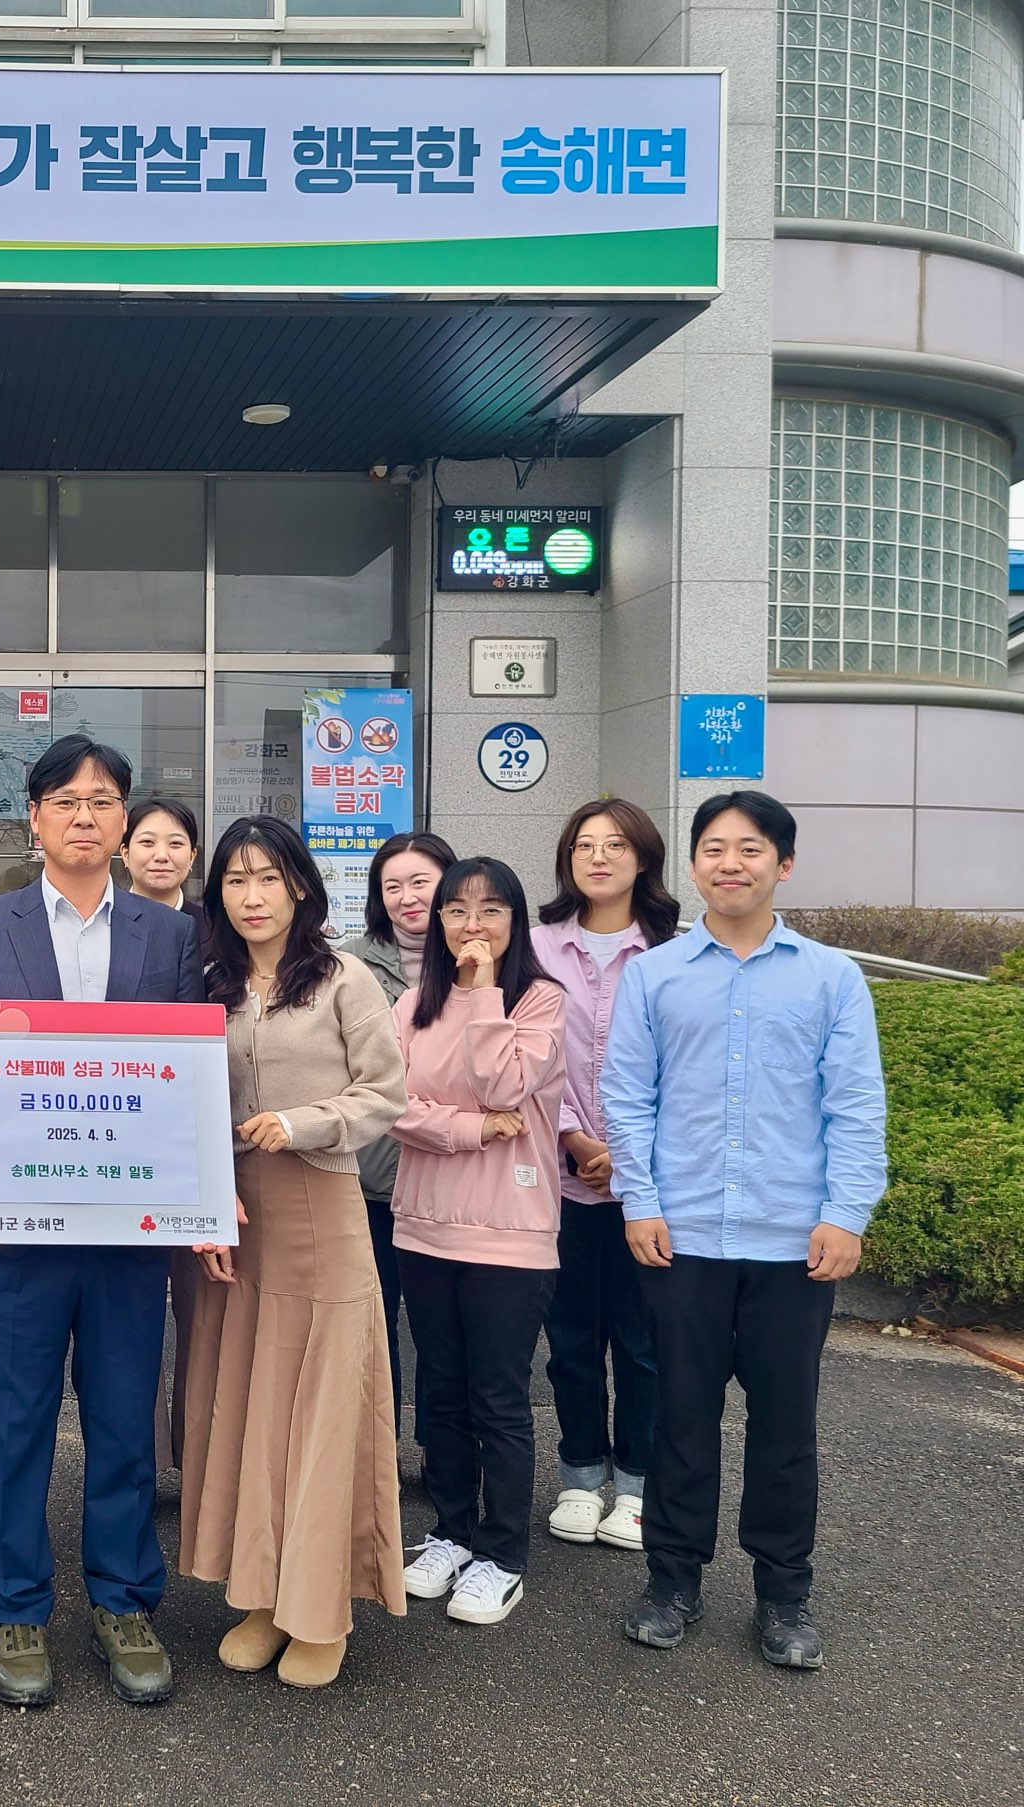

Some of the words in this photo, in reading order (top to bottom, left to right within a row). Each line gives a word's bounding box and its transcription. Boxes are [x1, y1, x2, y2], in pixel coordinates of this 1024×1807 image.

[78, 125, 268, 193] 잘살고
[292, 125, 481, 195] 행복한
[500, 126, 687, 195] 송해면
[453, 509, 476, 523] 우리
[479, 509, 503, 523] 동네
[506, 509, 553, 523] 미세먼지
[556, 509, 591, 523] 알리미
[244, 743, 289, 758] 강화군
[498, 749, 530, 769] 29
[310, 765, 404, 787] 불법소각
[500, 770, 528, 778] 전망대로
[335, 791, 381, 814] 금지
[308, 825, 354, 837] 푸른하늘을
[356, 825, 375, 837] 위한
[308, 838, 336, 849] 올바른
[337, 838, 366, 849] 폐기물
[4, 1059, 65, 1077] 산불피해
[73, 1061, 103, 1078] 성금
[111, 1061, 156, 1079] 기탁식
[47, 1127, 81, 1141] 2025.
[87, 1128, 99, 1142] 4.
[105, 1128, 117, 1142] 9.
[11, 1163, 89, 1178] 송해면사무소
[96, 1165, 121, 1179] 직원
[129, 1165, 154, 1179] 일동
[23, 1217, 65, 1231] 송해면
[159, 1216, 217, 1229] 사랑의열매
